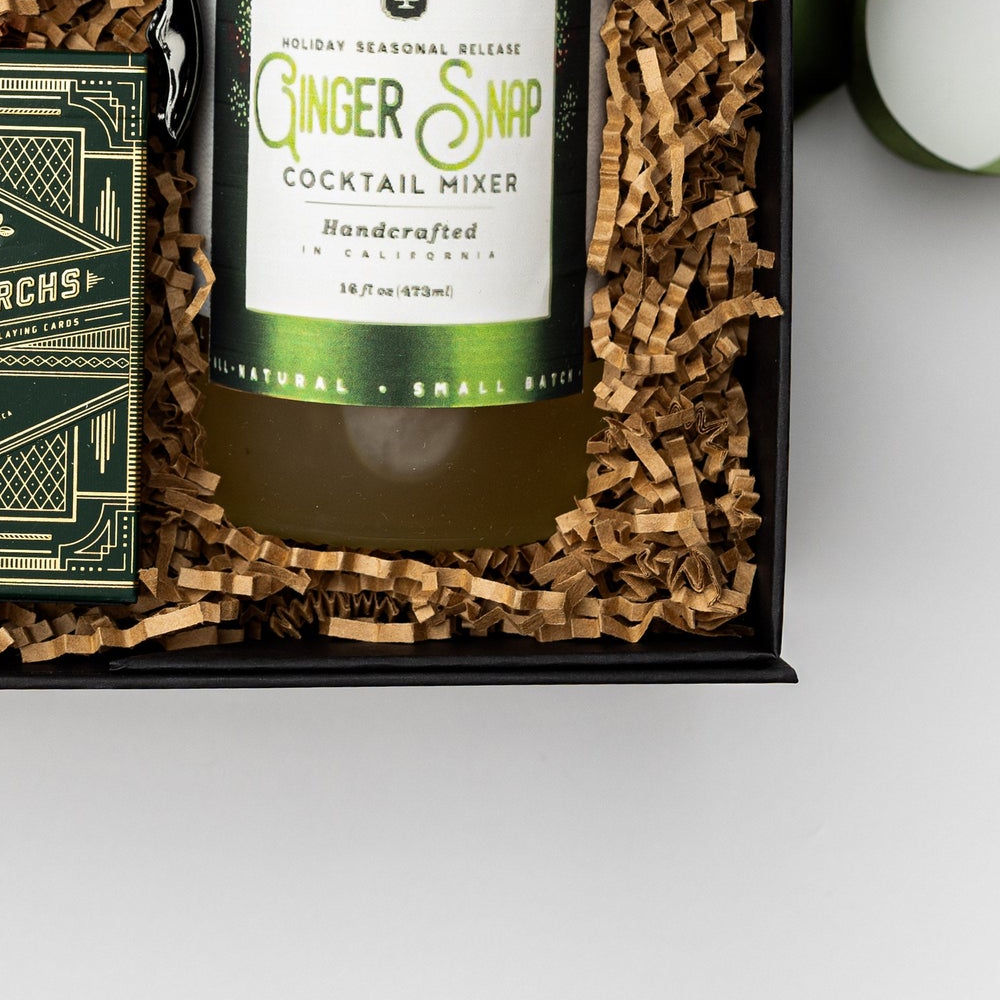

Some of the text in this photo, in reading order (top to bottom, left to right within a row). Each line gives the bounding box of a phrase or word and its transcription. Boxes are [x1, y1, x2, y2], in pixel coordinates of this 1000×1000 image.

[282, 37, 521, 56] HOLIDAY SEASONAL RELEASE
[283, 166, 518, 195] COCKTAIL MIXER
[321, 218, 479, 244] Handcrafted
[302, 245, 496, 260] IN CALIFORNIA
[339, 282, 358, 294] 16
[43, 318, 80, 332] CARDS
[413, 380, 504, 398] SMALL
[524, 368, 574, 390] BATCH
